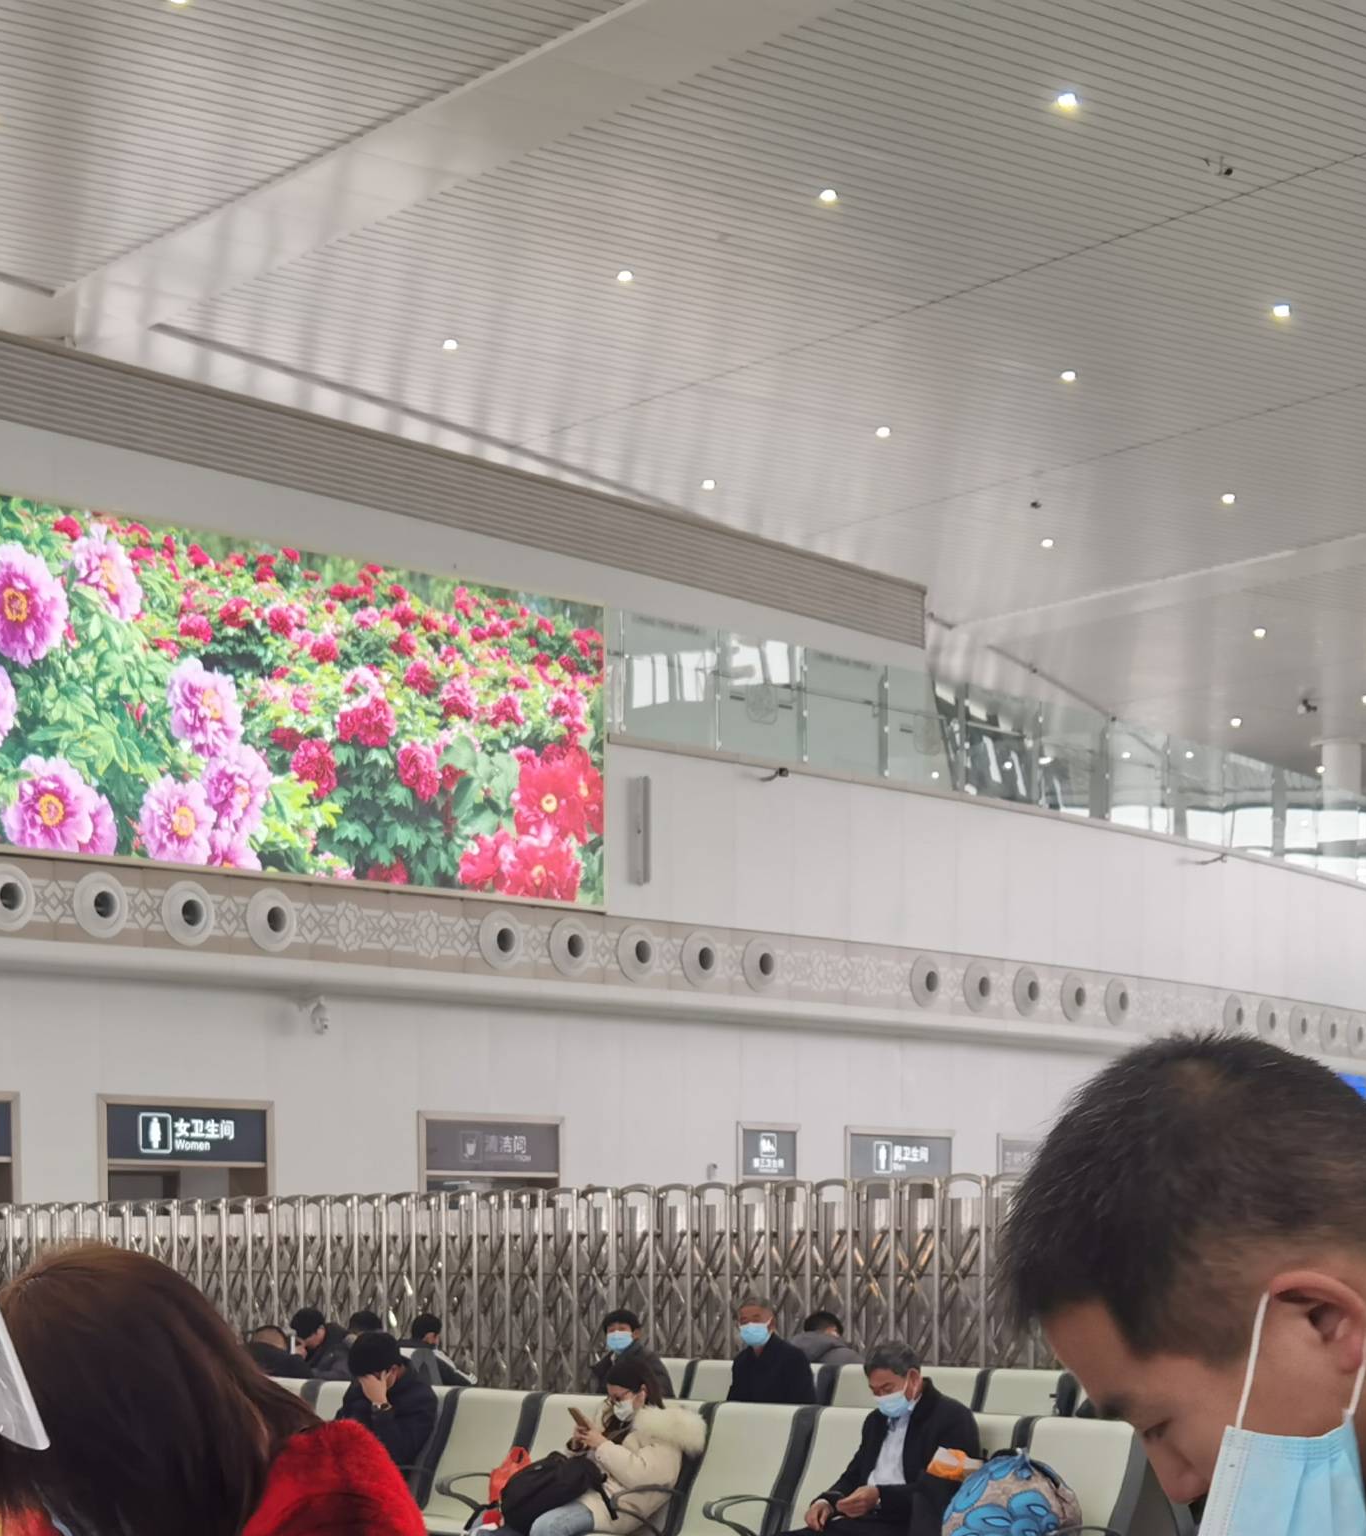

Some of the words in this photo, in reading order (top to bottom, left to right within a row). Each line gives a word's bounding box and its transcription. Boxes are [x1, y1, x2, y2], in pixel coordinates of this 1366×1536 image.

[174, 1118, 235, 1140] 女卫生间
[174, 1139, 211, 1151] Women
